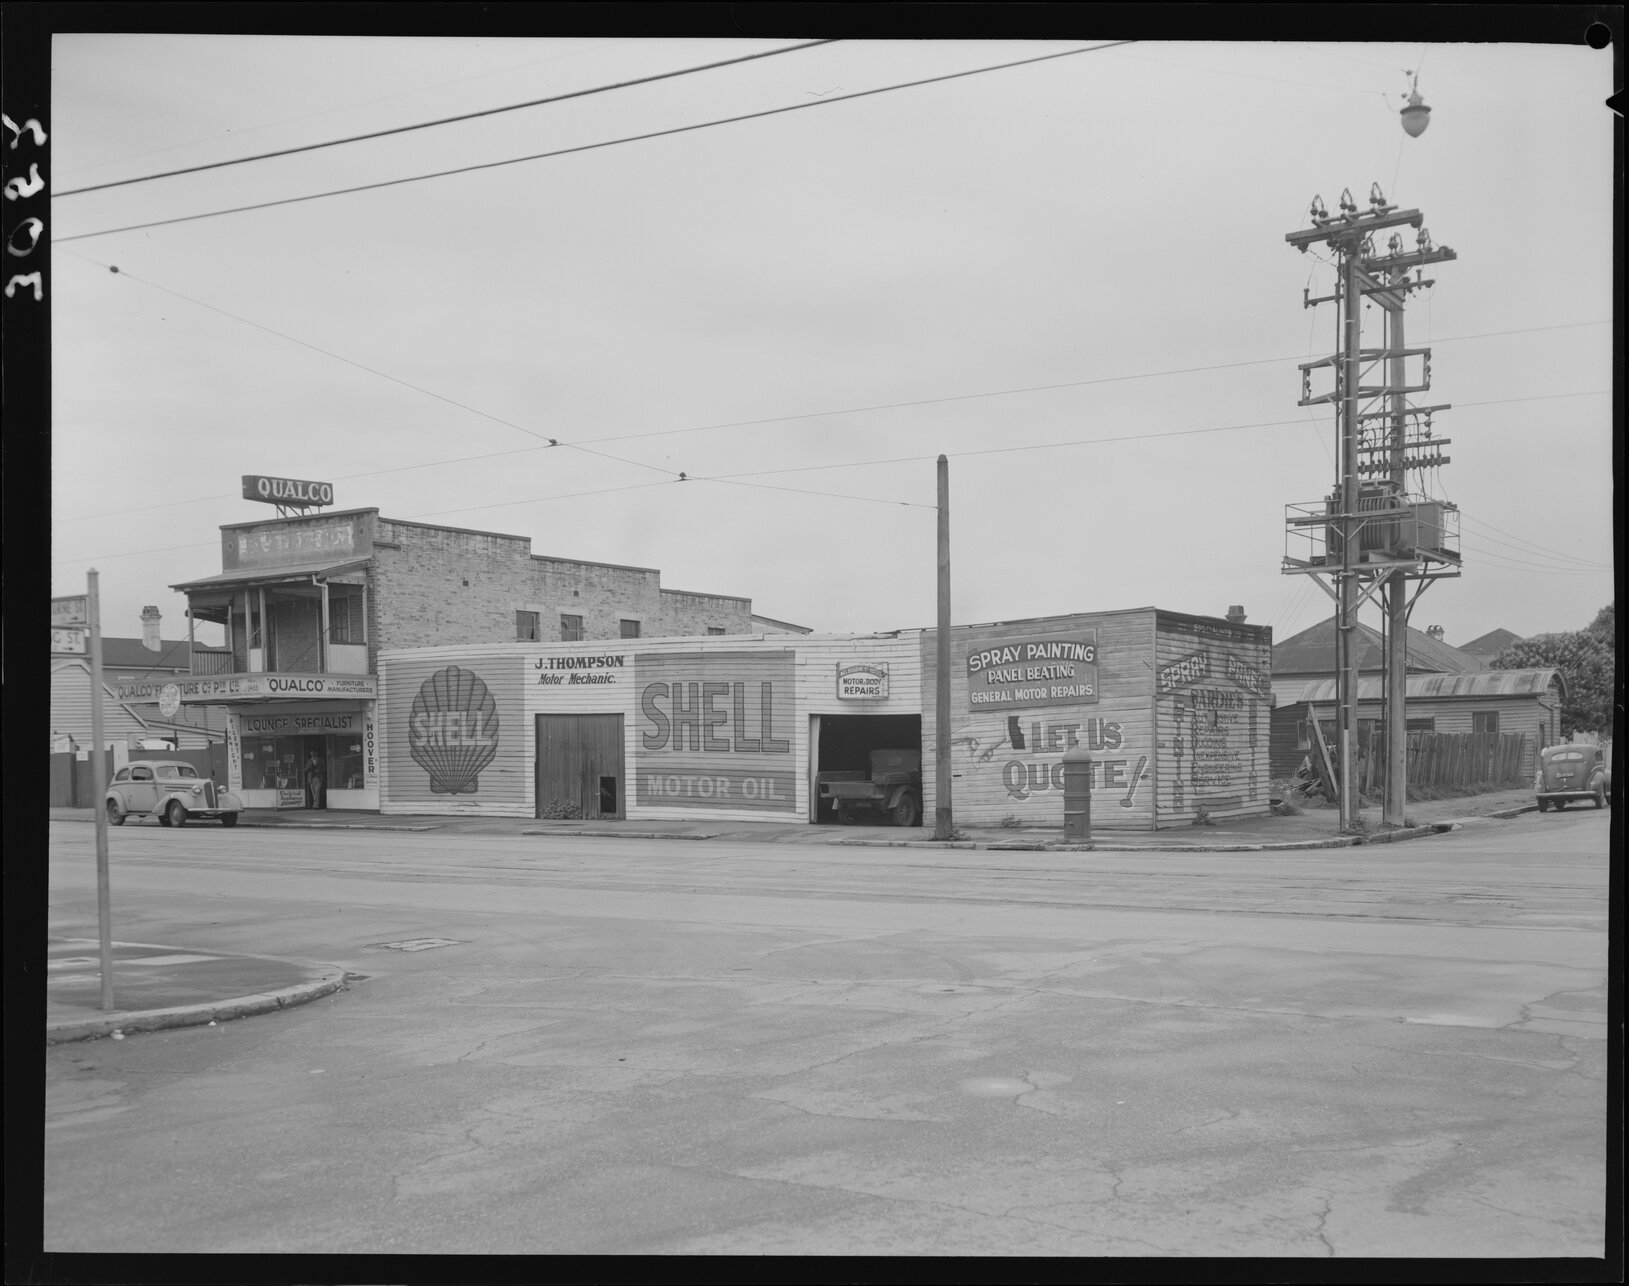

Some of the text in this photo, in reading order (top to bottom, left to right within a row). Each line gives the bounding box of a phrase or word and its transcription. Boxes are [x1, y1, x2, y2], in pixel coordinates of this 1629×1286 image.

[258, 478, 332, 502] QUALCO
[969, 642, 1095, 672] SPRAY PAINTING
[538, 672, 617, 685] Motor Mechanic.
[987, 664, 1075, 684] PANEL BEATING
[844, 686, 880, 695] REPAIRS
[971, 691, 1012, 704] GENERAL
[1014, 688, 1048, 701] MOTOR
[247, 716, 353, 732] LOUNGE SPECIALIST
[414, 711, 492, 746] SHELL
[641, 682, 790, 753] SHELL
[366, 723, 375, 773] HOOVER
[1031, 718, 1122, 753] LET US
[648, 774, 786, 800] MOTOR OIL
